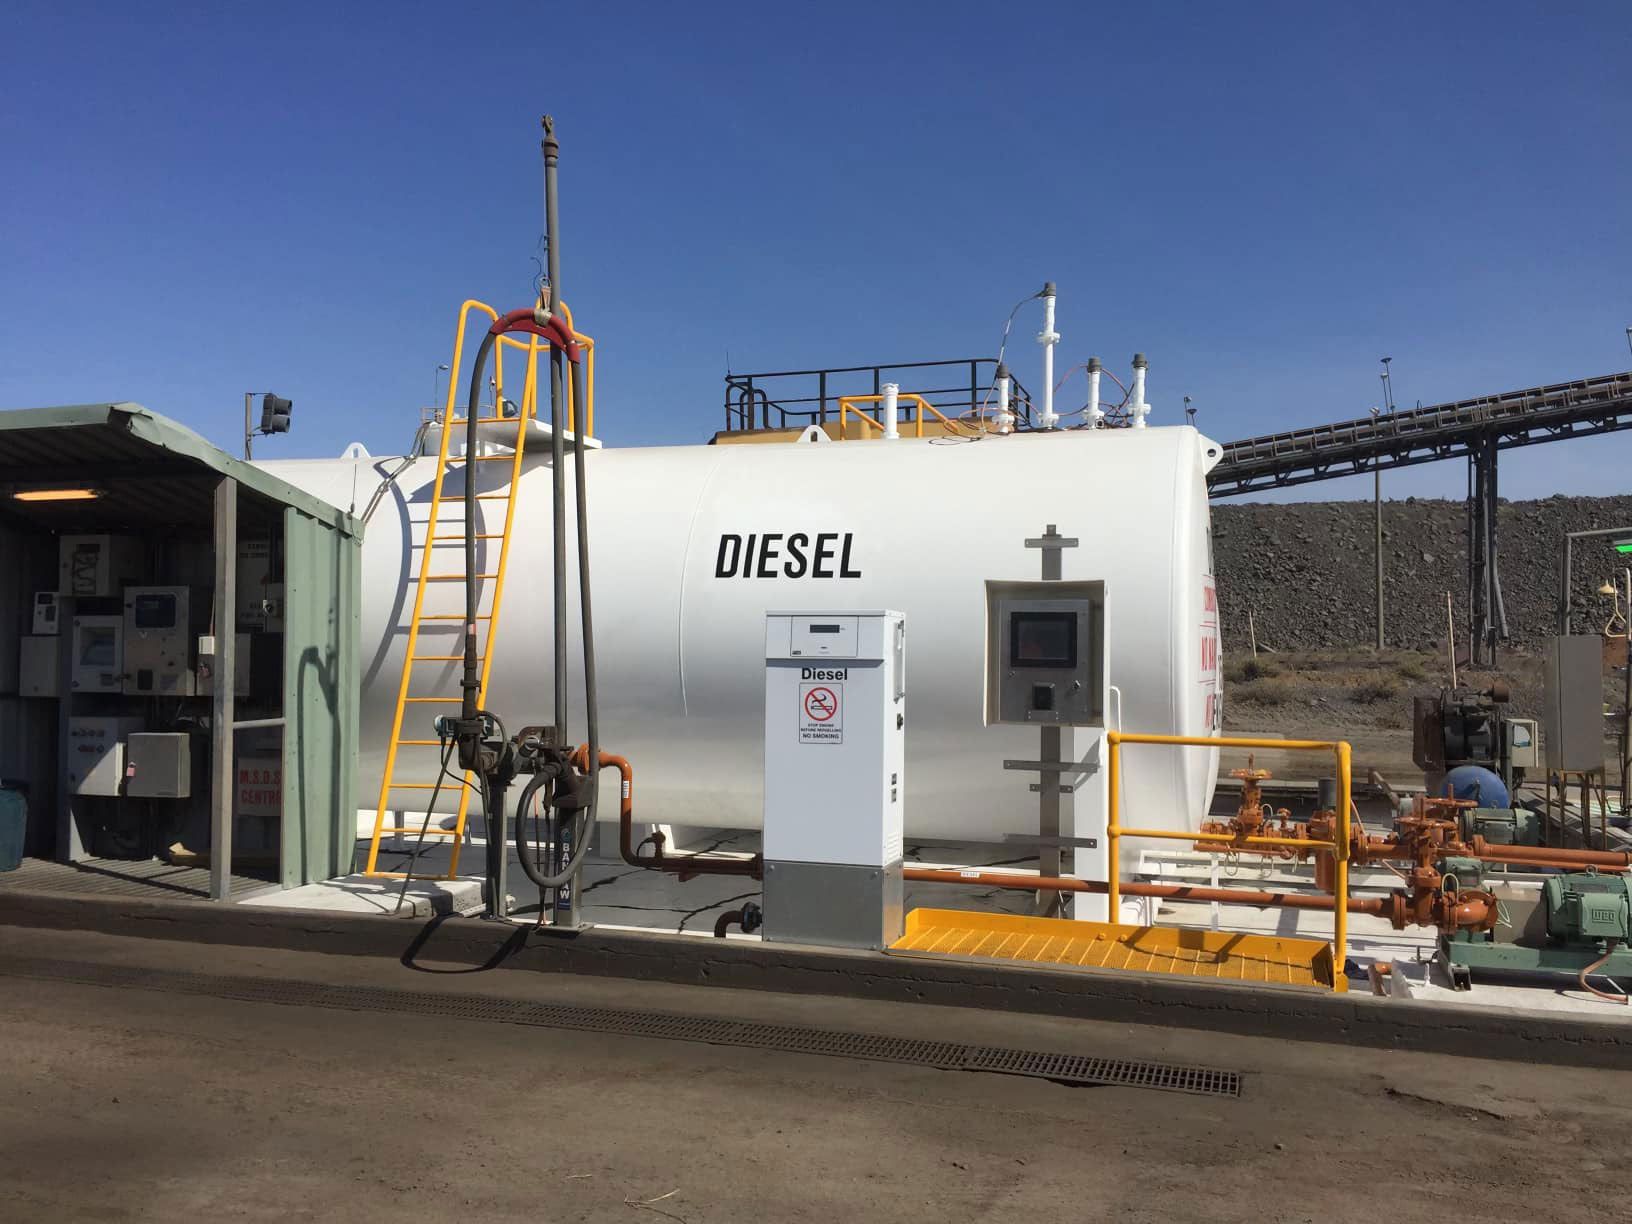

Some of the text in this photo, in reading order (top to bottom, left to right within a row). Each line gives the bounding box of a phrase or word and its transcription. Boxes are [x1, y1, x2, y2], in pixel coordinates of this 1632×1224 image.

[715, 533, 862, 579] DIESEL
[801, 667, 847, 680] Diesel
[560, 842, 570, 900] BANAW
